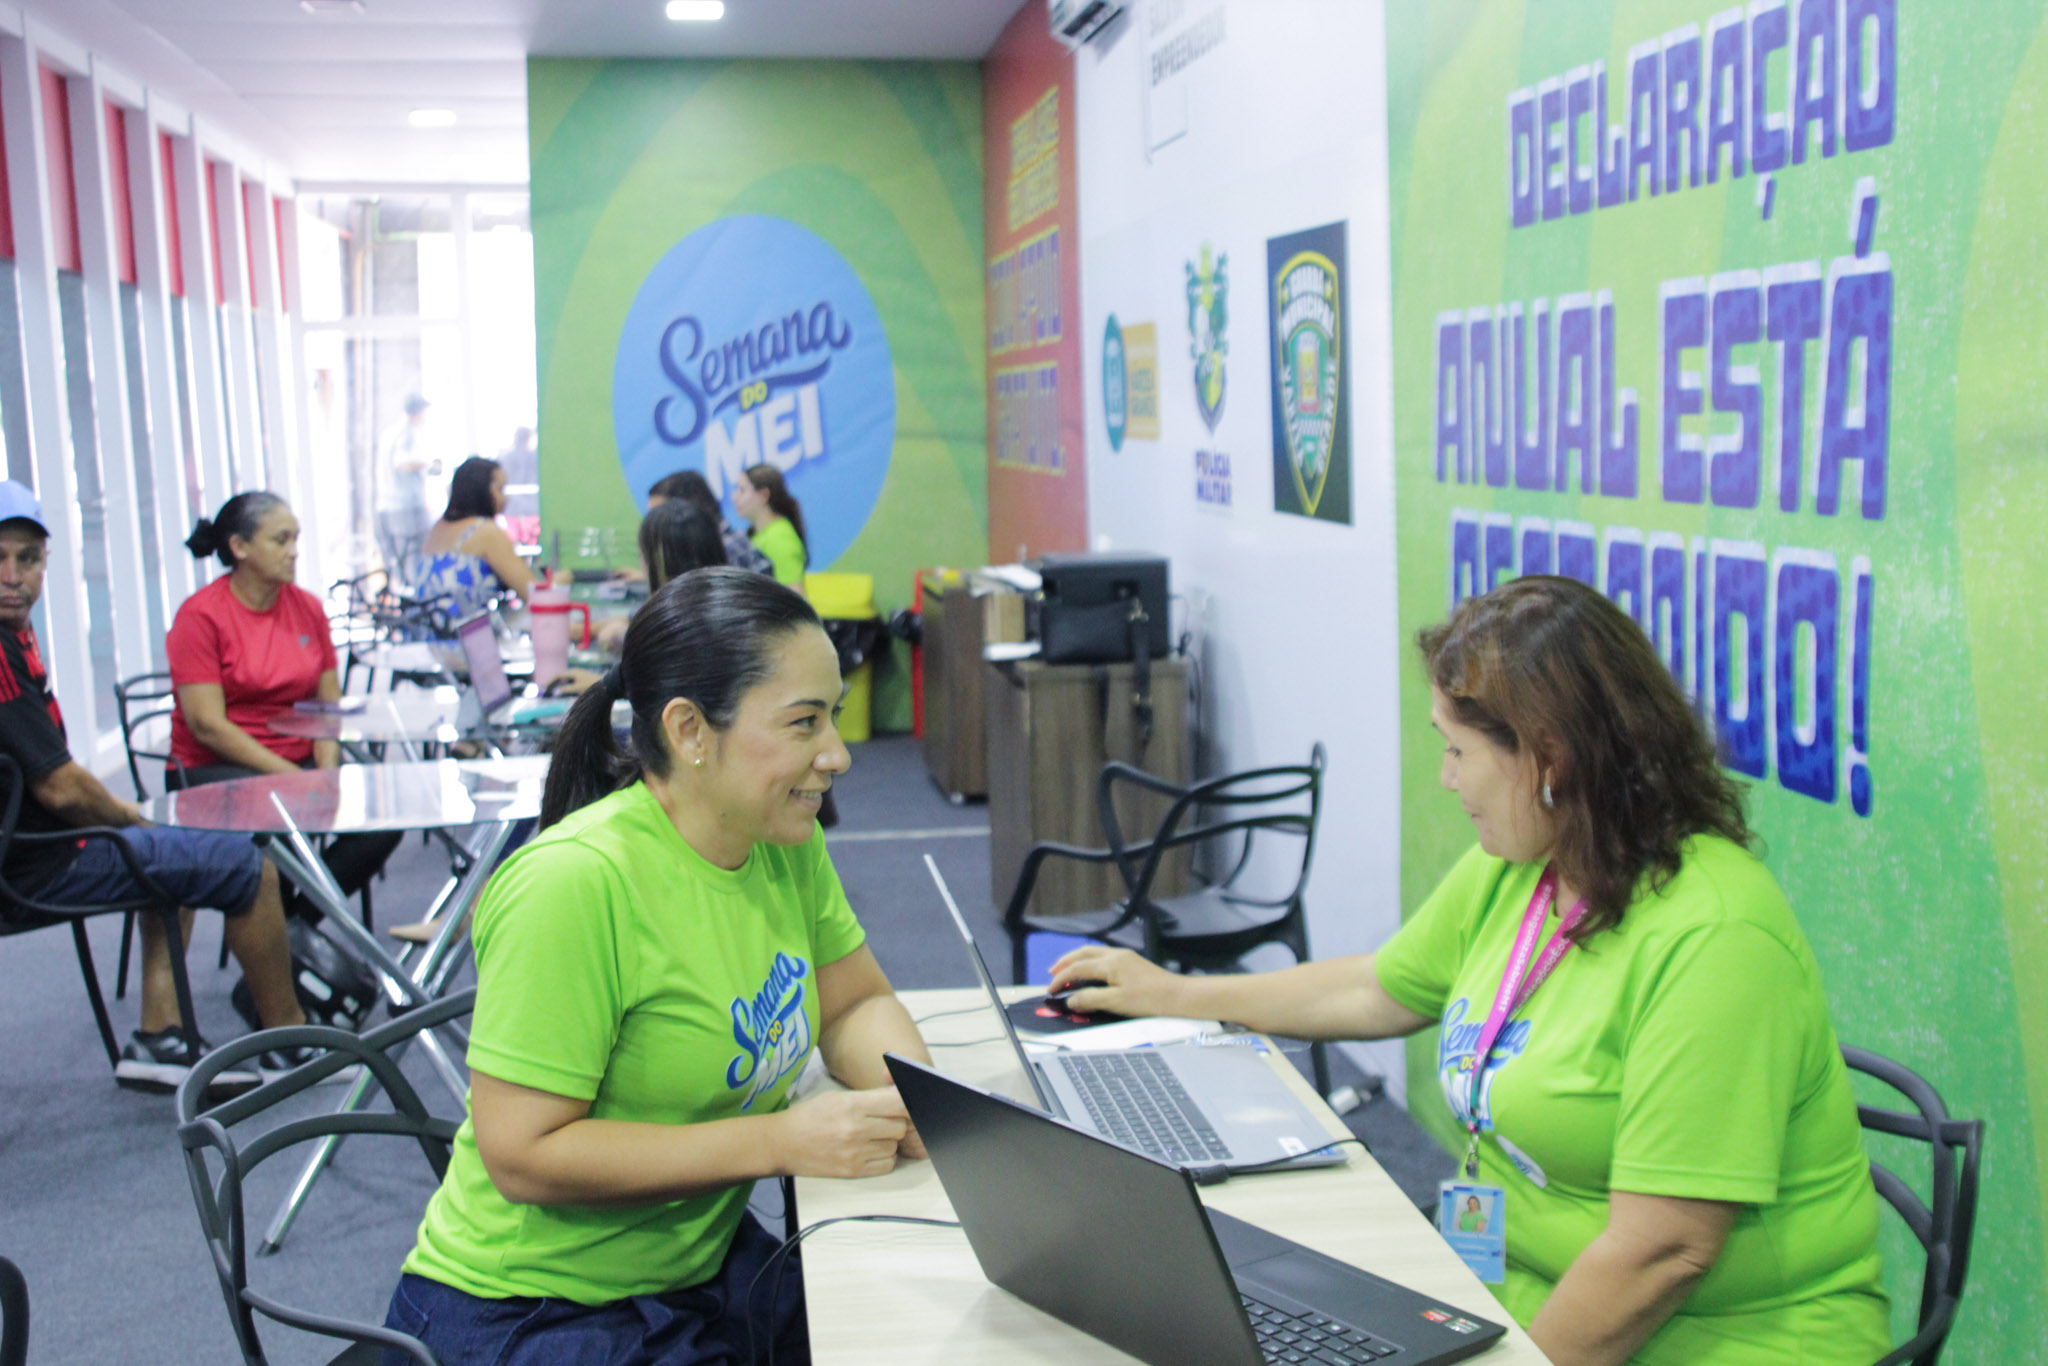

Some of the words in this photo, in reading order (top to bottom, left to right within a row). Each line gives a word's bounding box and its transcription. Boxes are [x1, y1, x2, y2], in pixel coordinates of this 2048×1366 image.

[654, 300, 852, 447] Semana
[740, 380, 768, 411] DO
[1435, 289, 1639, 498] ANUAL
[1658, 176, 1895, 520] ESTÁ
[704, 382, 824, 500] MEI
[769, 1020, 782, 1043] DO
